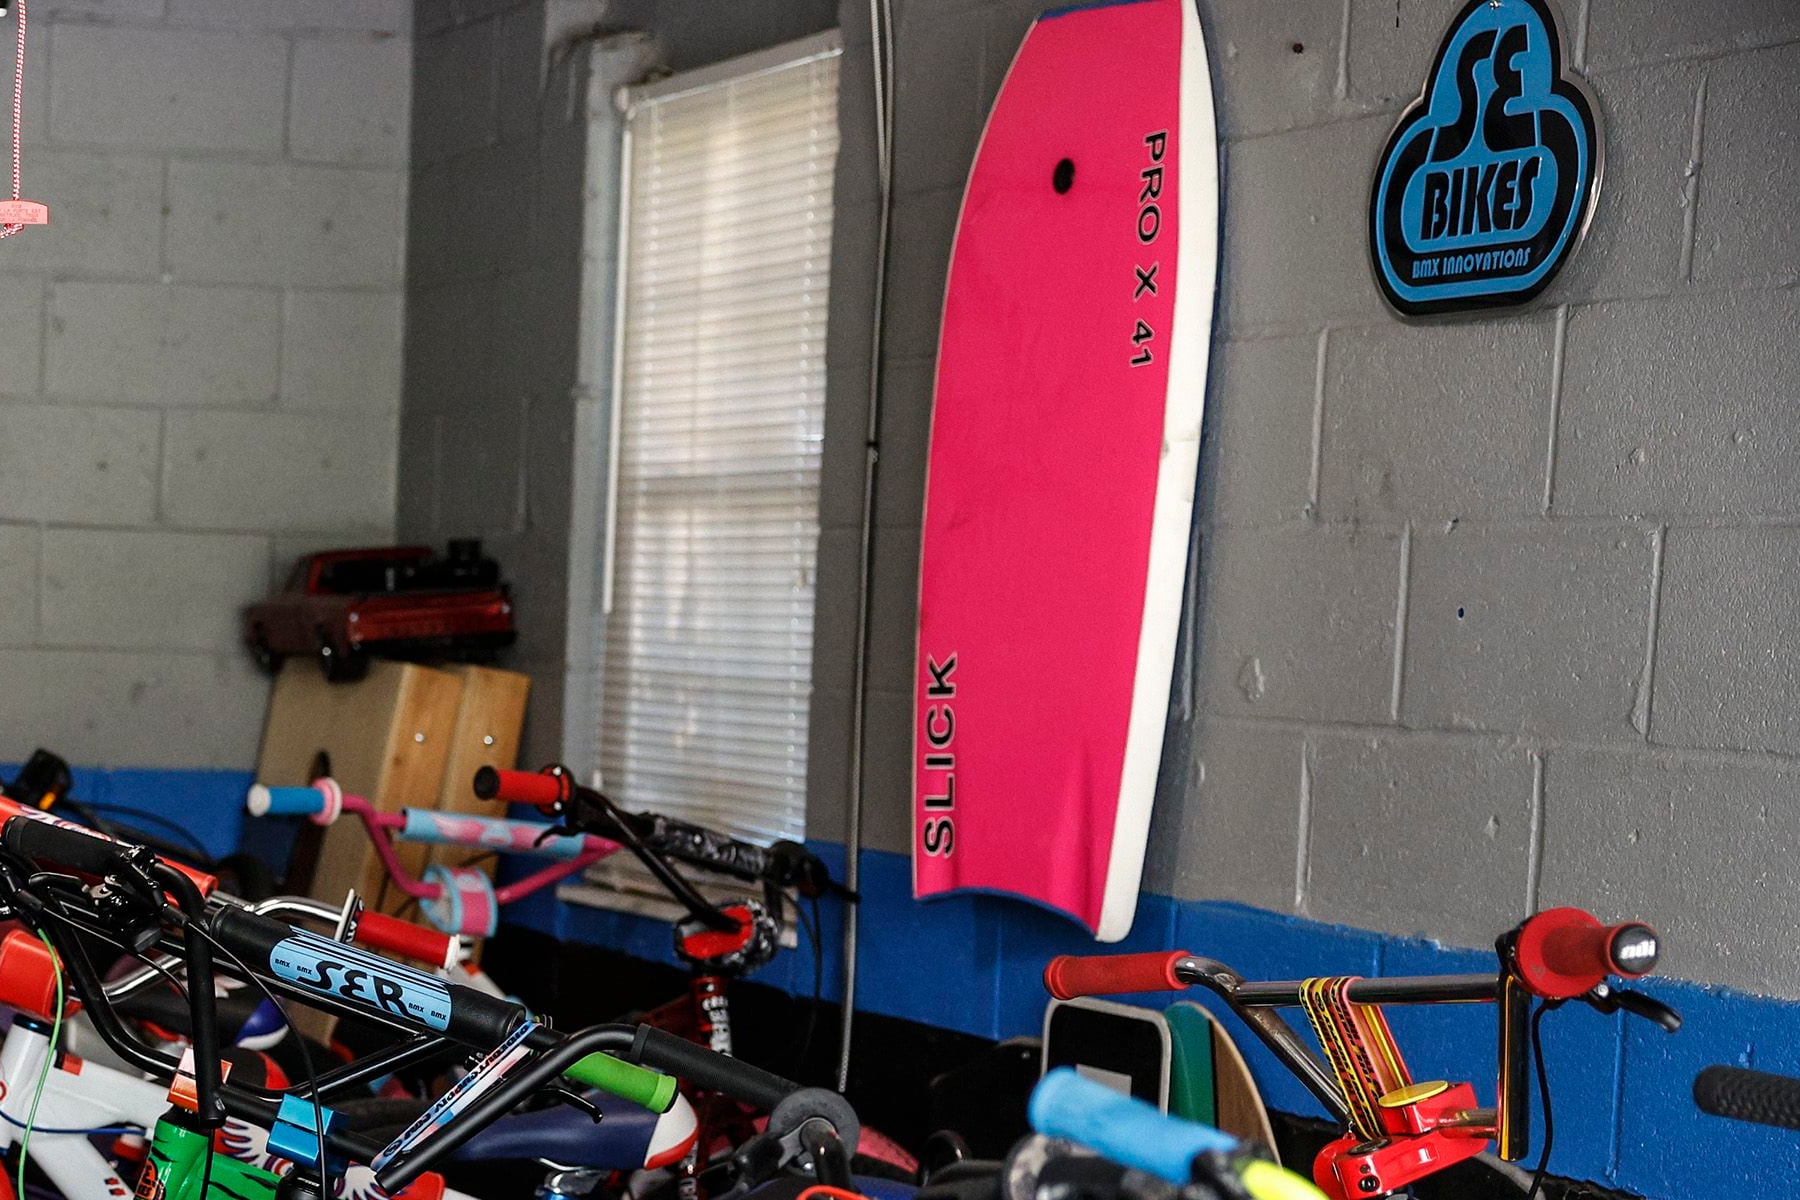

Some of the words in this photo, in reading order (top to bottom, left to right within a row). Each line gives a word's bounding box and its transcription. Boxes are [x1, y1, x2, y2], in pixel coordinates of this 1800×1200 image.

[1430, 23, 1541, 162] SE
[1136, 128, 1168, 246] PRO
[1420, 155, 1543, 240] BIKES
[1134, 260, 1160, 302] X
[1411, 260, 1440, 279] BMX
[1442, 247, 1531, 275] INNOVATIONS
[1129, 318, 1155, 368] 41
[924, 652, 958, 859] SLICK
[274, 957, 291, 969] BMX
[296, 964, 313, 976] BMX
[408, 1001, 425, 1014] BMX
[430, 1009, 447, 1021] BMX
